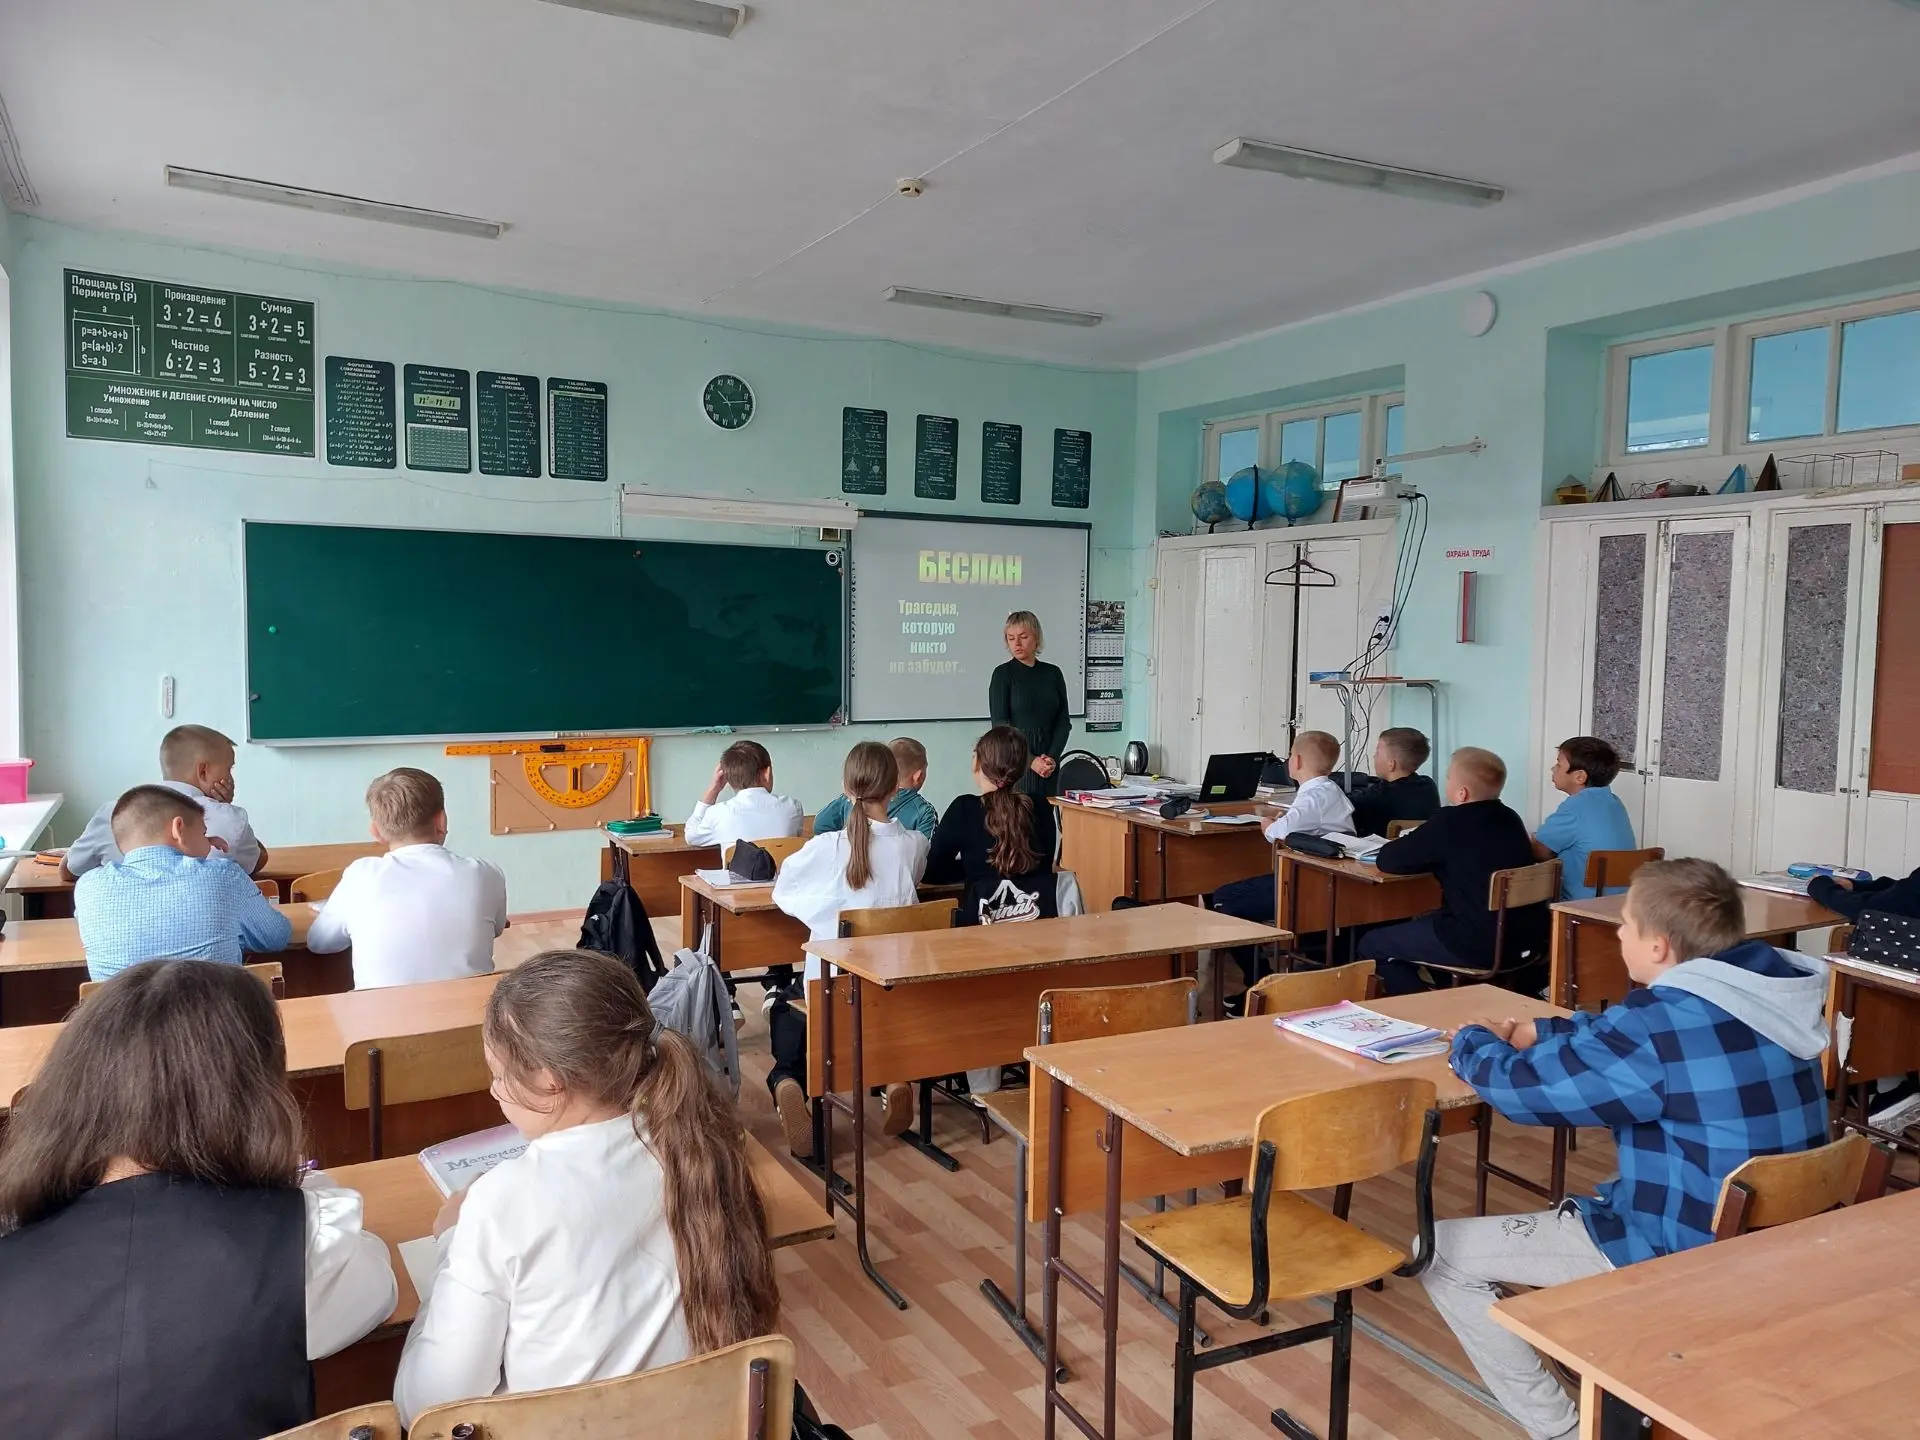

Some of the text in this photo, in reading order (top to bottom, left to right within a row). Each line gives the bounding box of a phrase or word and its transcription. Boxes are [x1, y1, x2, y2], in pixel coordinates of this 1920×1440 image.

[72, 275, 134, 292] Площадь (S)
[72, 286, 137, 303] Периметр (P)
[165, 288, 226, 305] Произведение
[164, 304, 171, 321] 3
[187, 308, 194, 324] 2
[214, 311, 222, 327] 6
[261, 301, 292, 314] Сумма
[249, 315, 256, 331] 3
[271, 318, 278, 334] 2
[297, 321, 304, 337] 5
[171, 339, 210, 352] Частное
[166, 353, 173, 369] 6
[185, 355, 193, 372] 2
[213, 358, 221, 374] 3
[254, 349, 294, 362] Разность
[249, 362, 256, 379] 5
[272, 365, 280, 382] 2
[298, 368, 306, 384] 3
[103, 394, 150, 406] Умножение
[108, 385, 160, 398] УМНОЖЕНИЕ
[169, 391, 206, 402] ДЕЛЕНИЕ
[208, 395, 238, 405] СУММЫ
[239, 398, 250, 406] НА
[251, 399, 277, 409] ЧИСЛО
[230, 408, 270, 420] Деление
[918, 550, 1022, 586] БЕСЛАН
[902, 621, 955, 635] которую
[910, 642, 946, 654] никто
[889, 661, 904, 673] не
